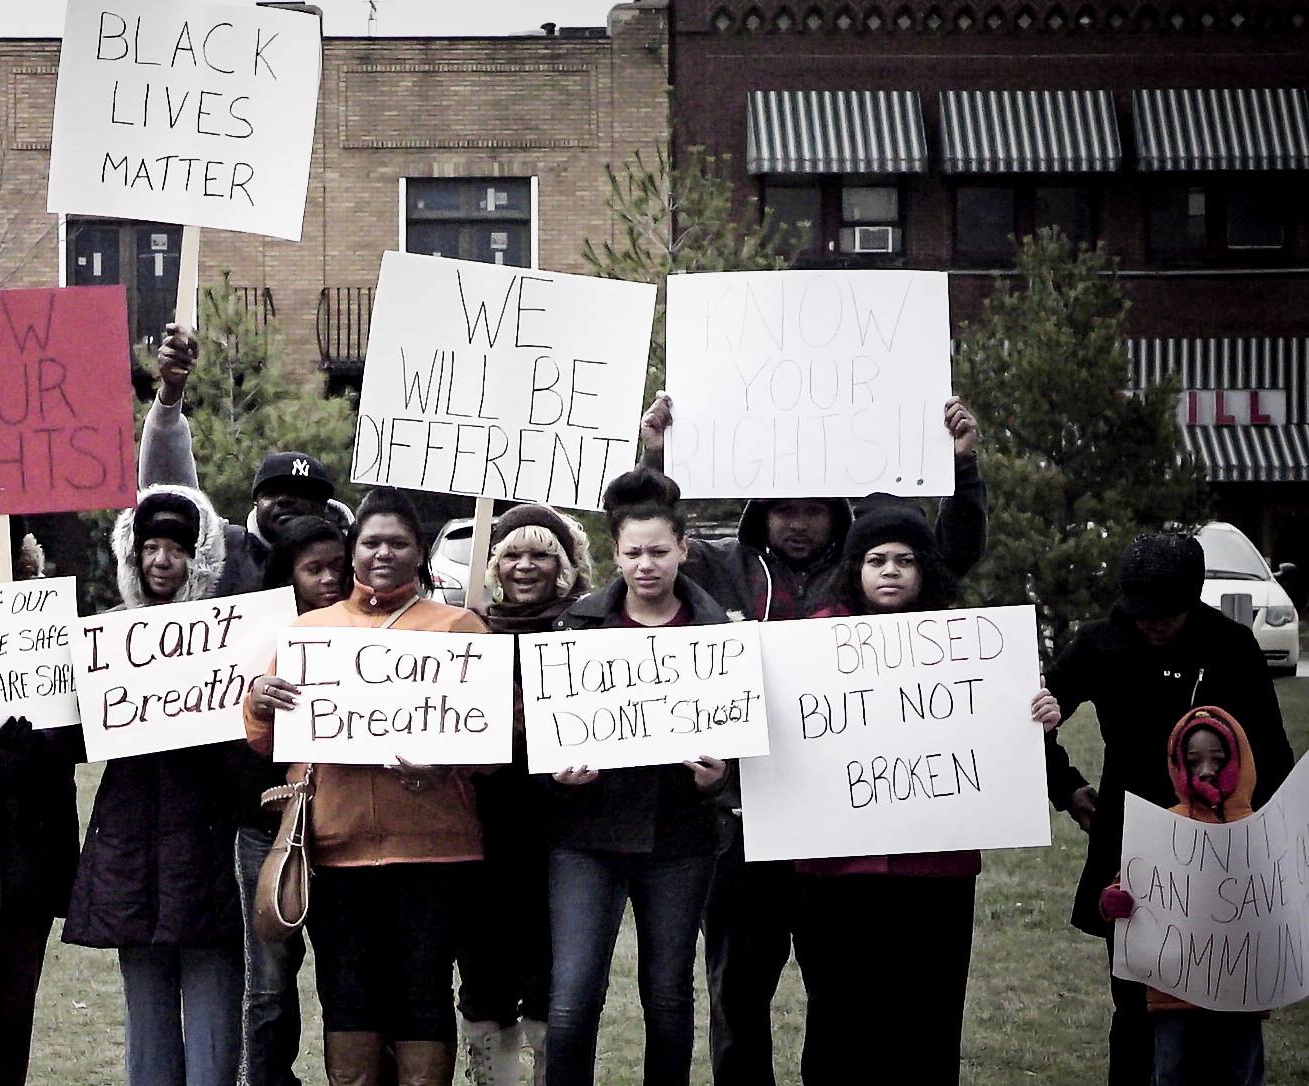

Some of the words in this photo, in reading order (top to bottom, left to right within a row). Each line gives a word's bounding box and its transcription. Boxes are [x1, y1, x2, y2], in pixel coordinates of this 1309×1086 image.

[96, 11, 280, 80] BLACK
[111, 80, 254, 138] LIVES
[100, 151, 255, 207] MATTER
[456, 268, 554, 349] WE
[705, 274, 914, 353] KNOW
[400, 346, 500, 421] WILL
[528, 355, 608, 430] BE
[734, 354, 881, 412] YOUR
[1188, 390, 1271, 424] ILL
[352, 414, 631, 510] DIFFERENT
[670, 400, 927, 490] RIGHTS!!
[83, 626, 110, 674] I
[125, 604, 243, 668] Can't
[288, 639, 341, 687] I
[354, 642, 483, 684] Can't
[534, 635, 681, 702] Hands
[830, 615, 1005, 677] BRUISED
[102, 663, 265, 731] Breath
[310, 694, 489, 741] Breathe
[798, 688, 875, 740] BUT
[898, 678, 985, 724] NOT
[846, 748, 982, 810] BROKEN
[1126, 856, 1190, 918] CAN
[1210, 848, 1290, 924] SAVE
